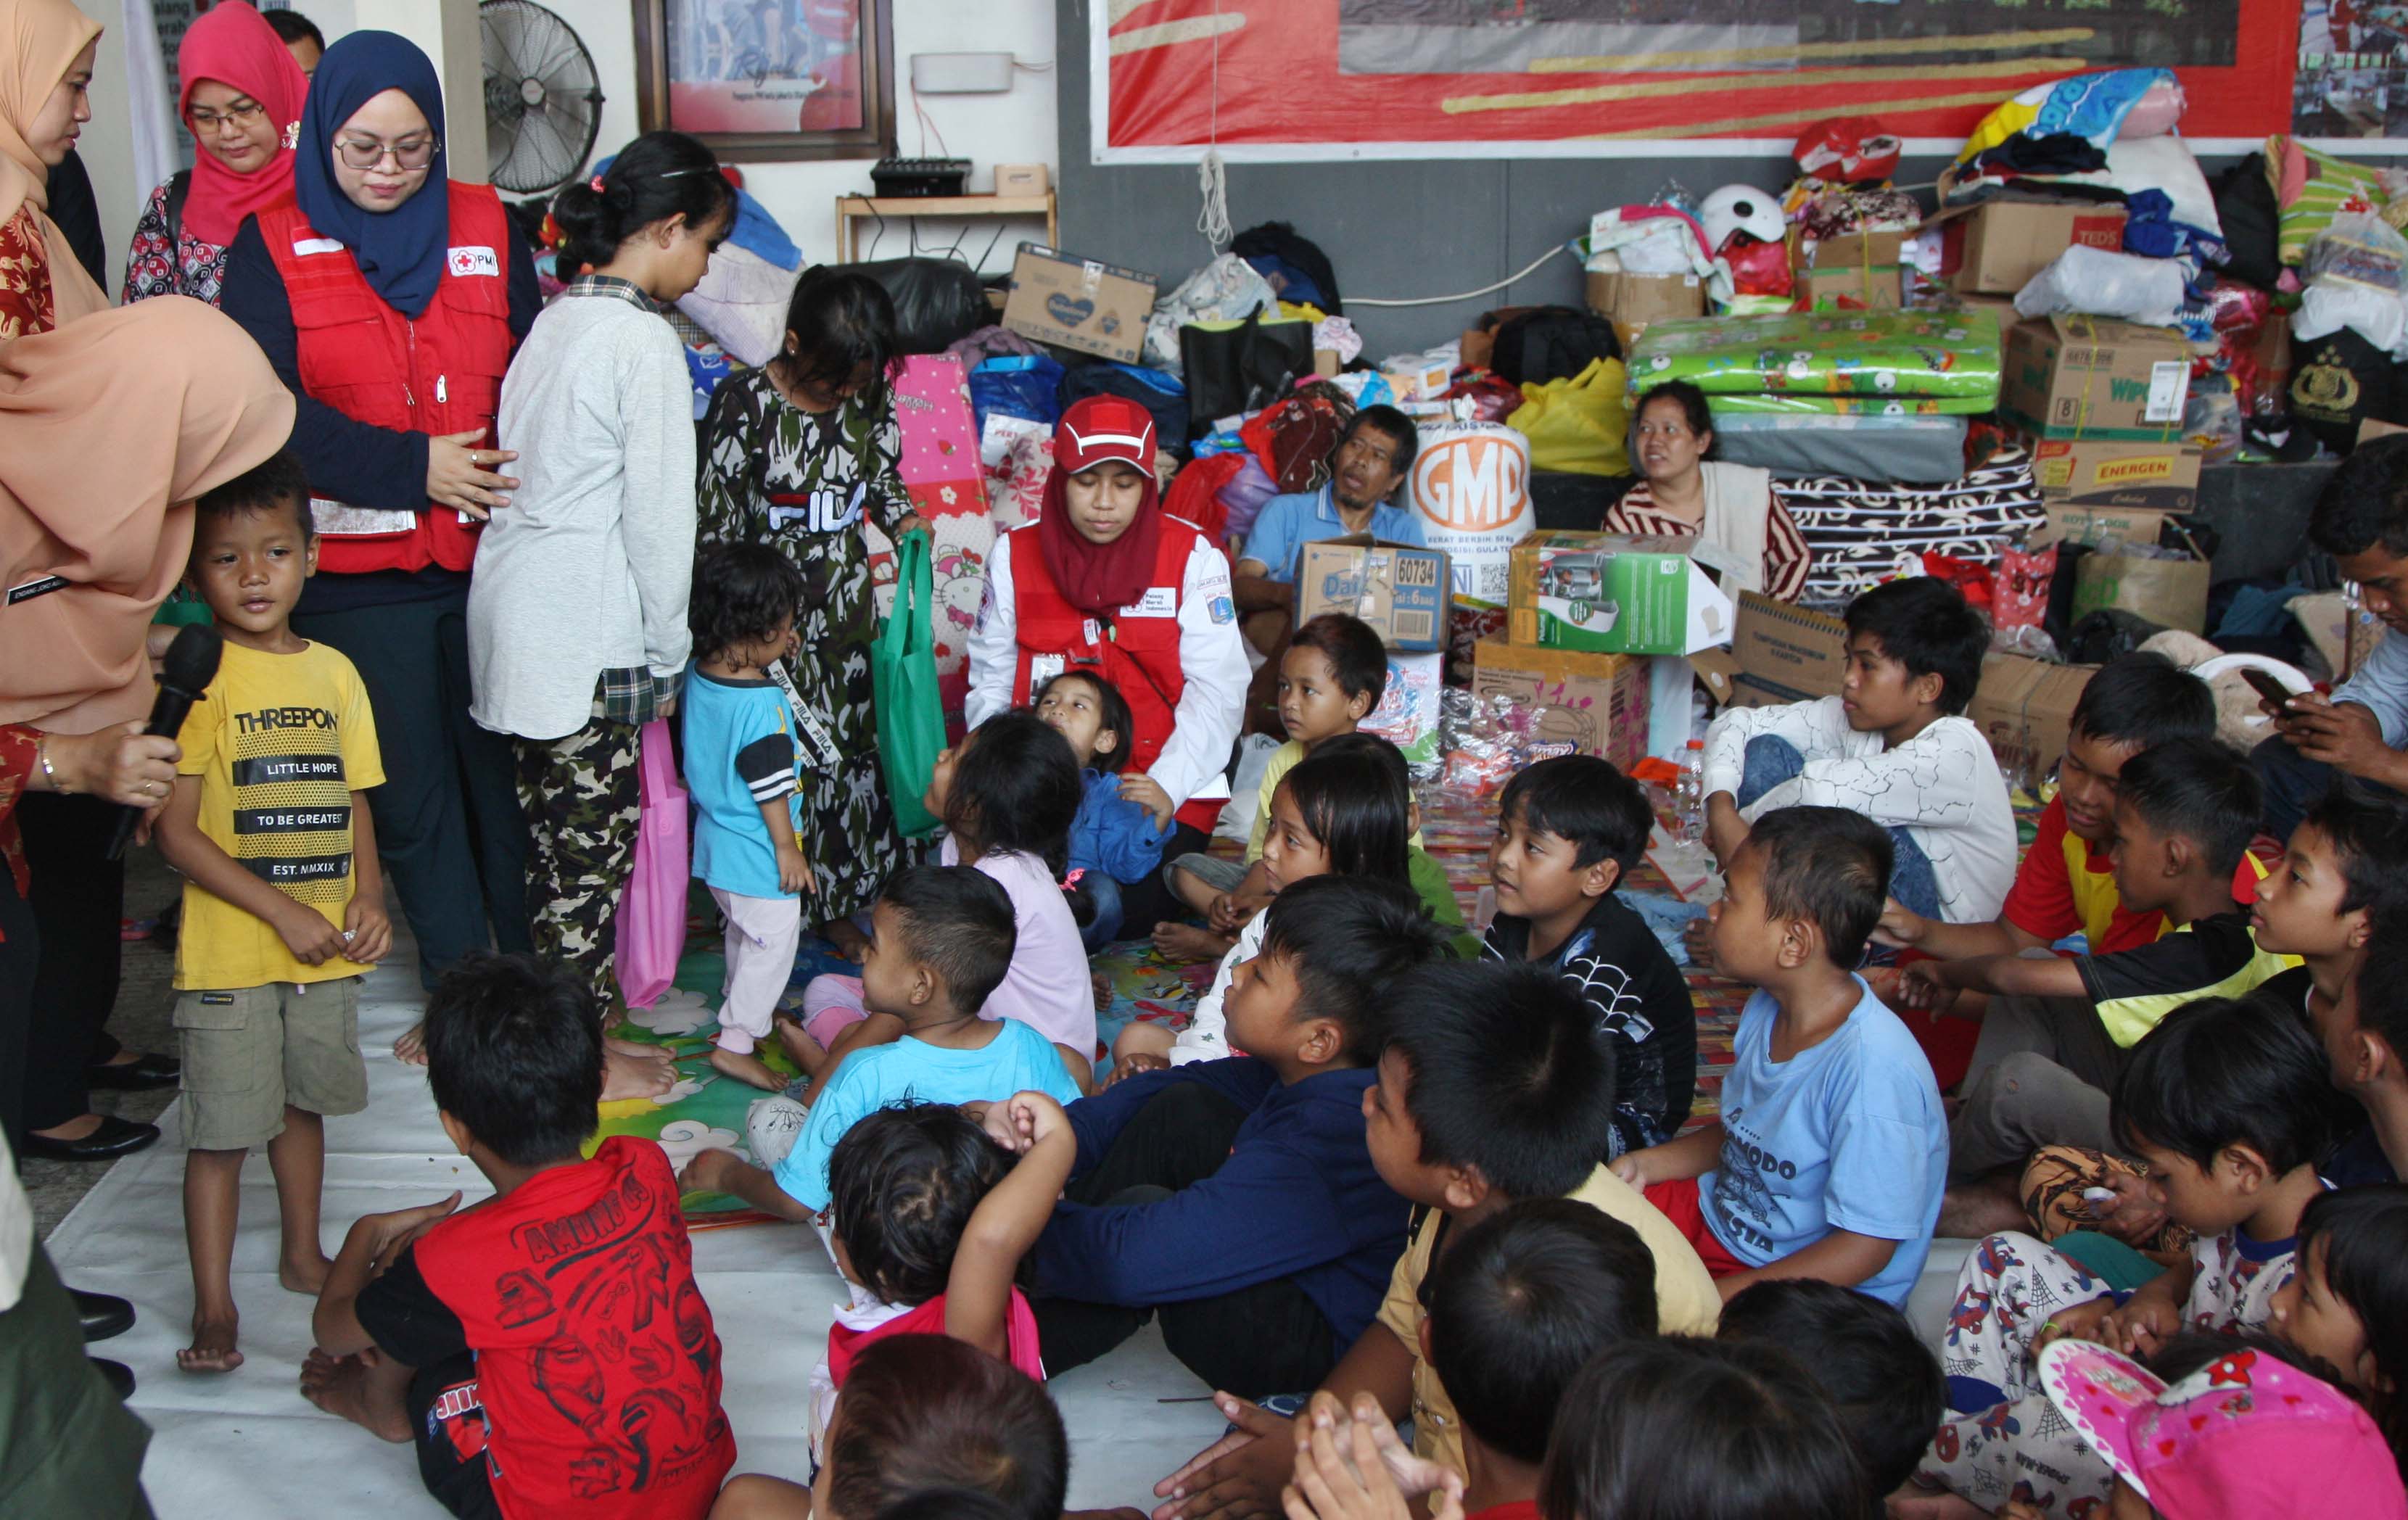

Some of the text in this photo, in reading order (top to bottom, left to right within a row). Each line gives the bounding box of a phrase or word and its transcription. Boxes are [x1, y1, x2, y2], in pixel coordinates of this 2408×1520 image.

[154, 1, 190, 16] alang
[477, 255, 496, 268] PMI
[2100, 462, 2167, 479] ENERGEN
[1418, 442, 1522, 525] GMP
[1398, 559, 1435, 584] 60734
[773, 669, 833, 754] FILA FILA FILA
[234, 707, 339, 734] THREEPOIN
[267, 763, 338, 775] LITTLE HOPE
[257, 813, 342, 826] TO BE GREATEST
[273, 862, 335, 876] EST. MMXIX
